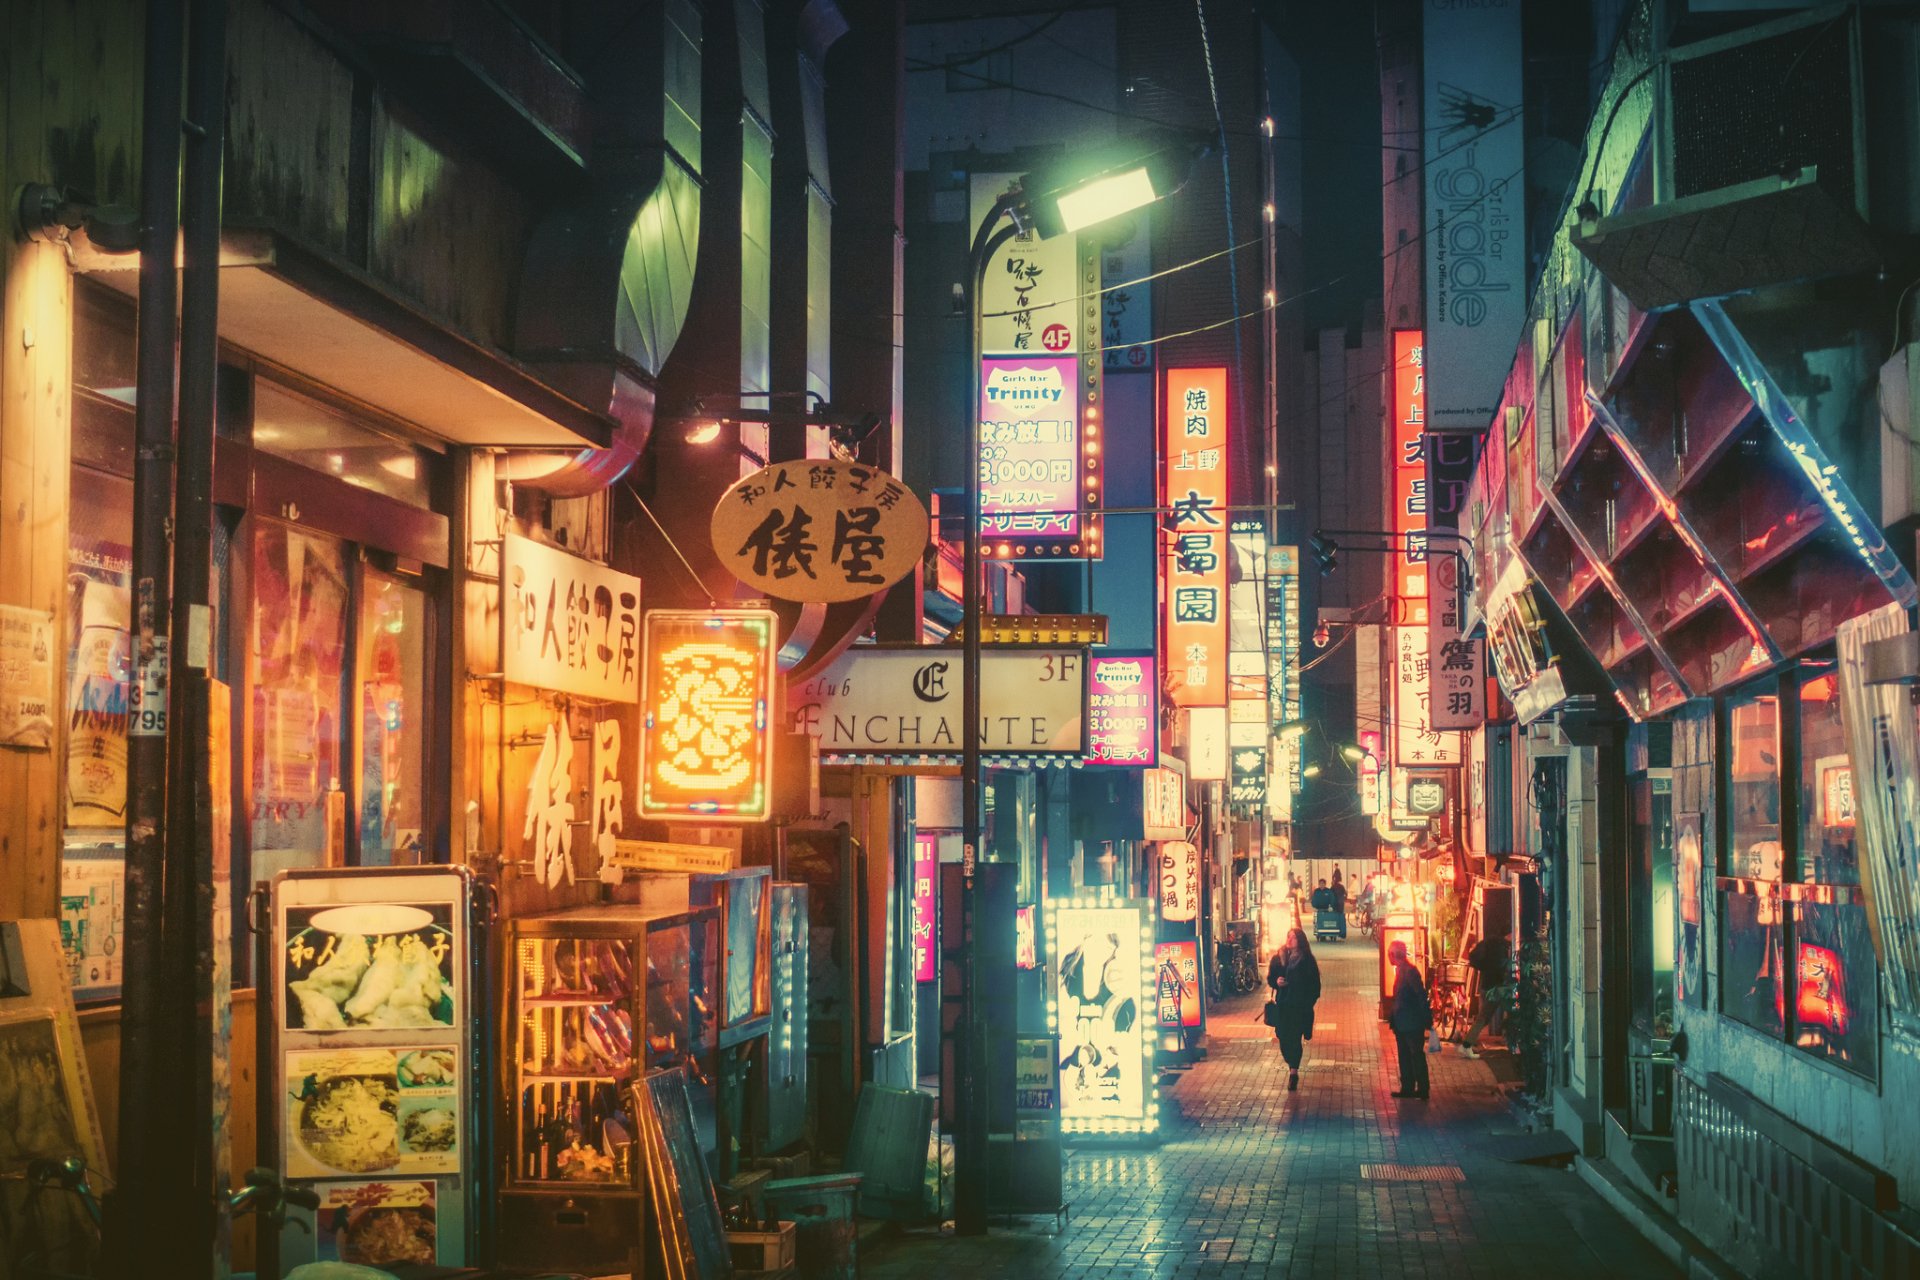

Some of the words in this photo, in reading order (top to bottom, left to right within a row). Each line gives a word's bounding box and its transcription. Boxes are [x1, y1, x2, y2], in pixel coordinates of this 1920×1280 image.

[1436, 208, 1444, 253] produced
[1436, 254, 1446, 262] by
[1489, 229, 1509, 260] Bar
[1437, 263, 1445, 290] Office
[1437, 291, 1445, 323] Kokoro
[1043, 330, 1069, 347] 4F
[988, 387, 1061, 401] Trinity
[1186, 389, 1208, 436] 焼肉
[980, 460, 1072, 484] 3,000円
[1175, 449, 1220, 470] 上野
[735, 503, 886, 585] 俵屋
[1174, 490, 1221, 624] 太昌園
[1039, 654, 1077, 682] 3F
[1096, 673, 1141, 682] Trinity
[1187, 643, 1207, 685] 本店
[1440, 639, 1475, 715] 鷹の羽
[805, 678, 851, 696] club
[130, 709, 167, 731] 795
[1411, 749, 1448, 761] 本店
[1162, 853, 1179, 908] もつ鍋
